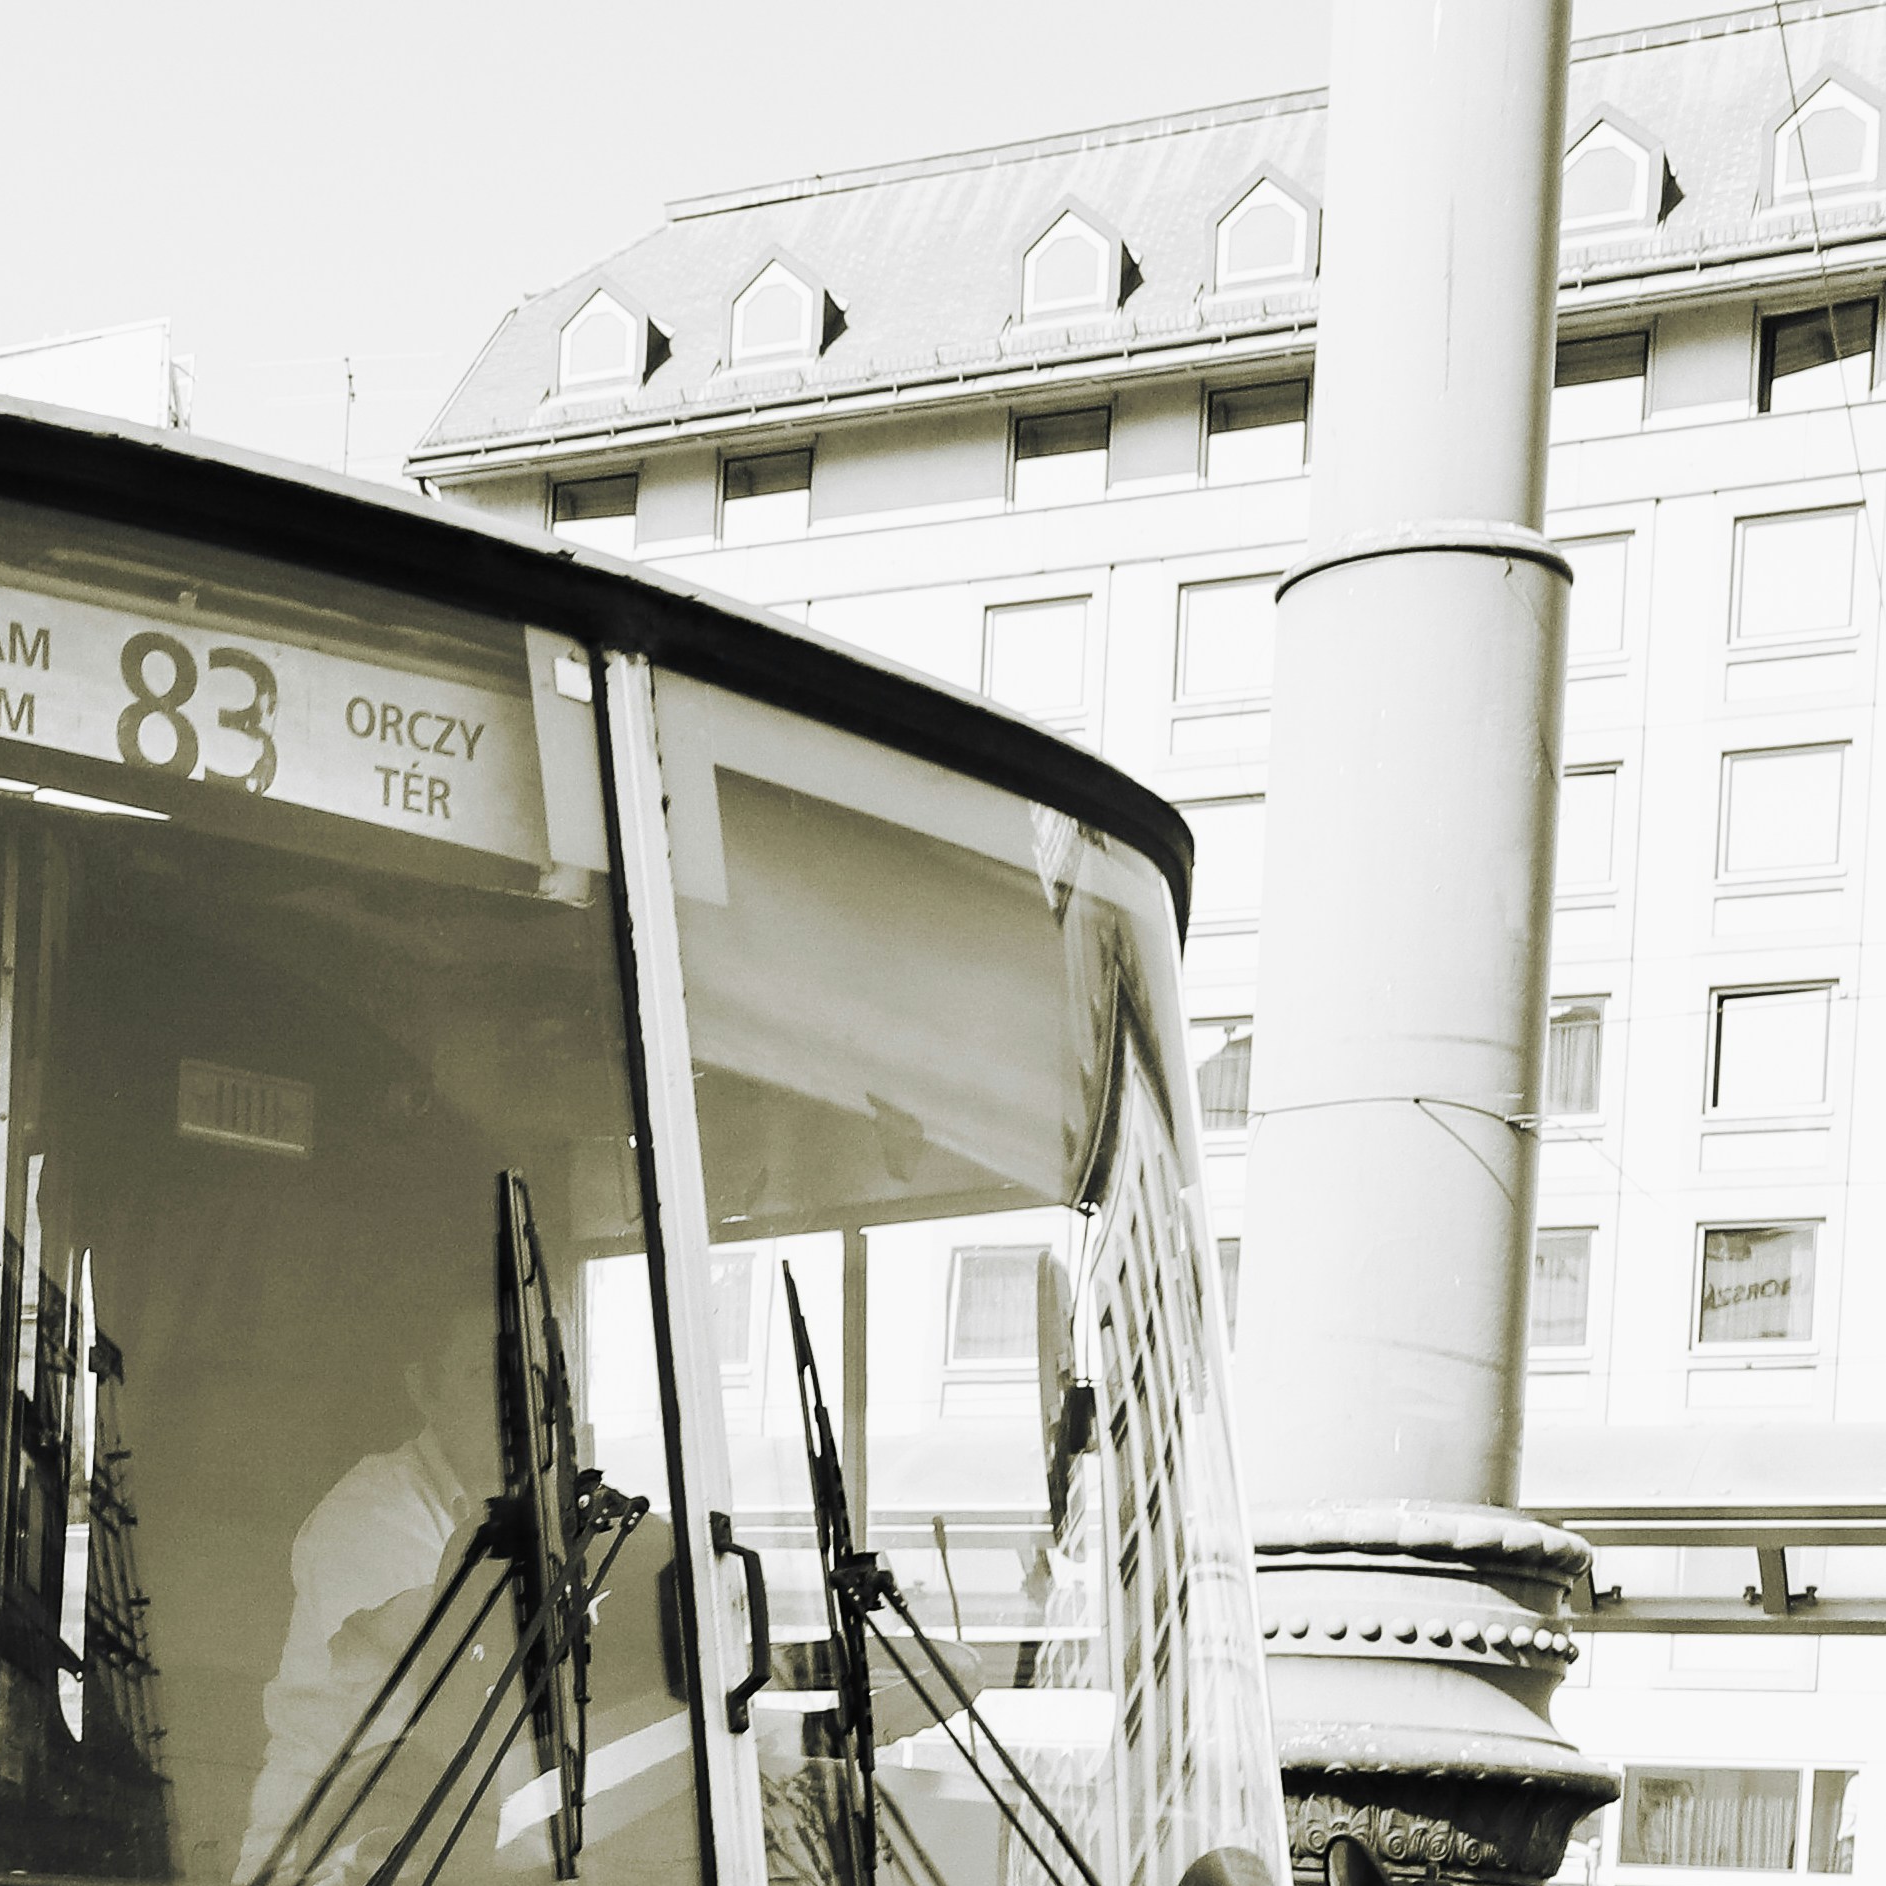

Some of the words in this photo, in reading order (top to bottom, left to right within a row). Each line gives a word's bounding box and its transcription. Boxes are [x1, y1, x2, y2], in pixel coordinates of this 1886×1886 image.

[117, 631, 278, 797] 83
[345, 695, 485, 763] ORCZY
[374, 762, 453, 820] TÉR
